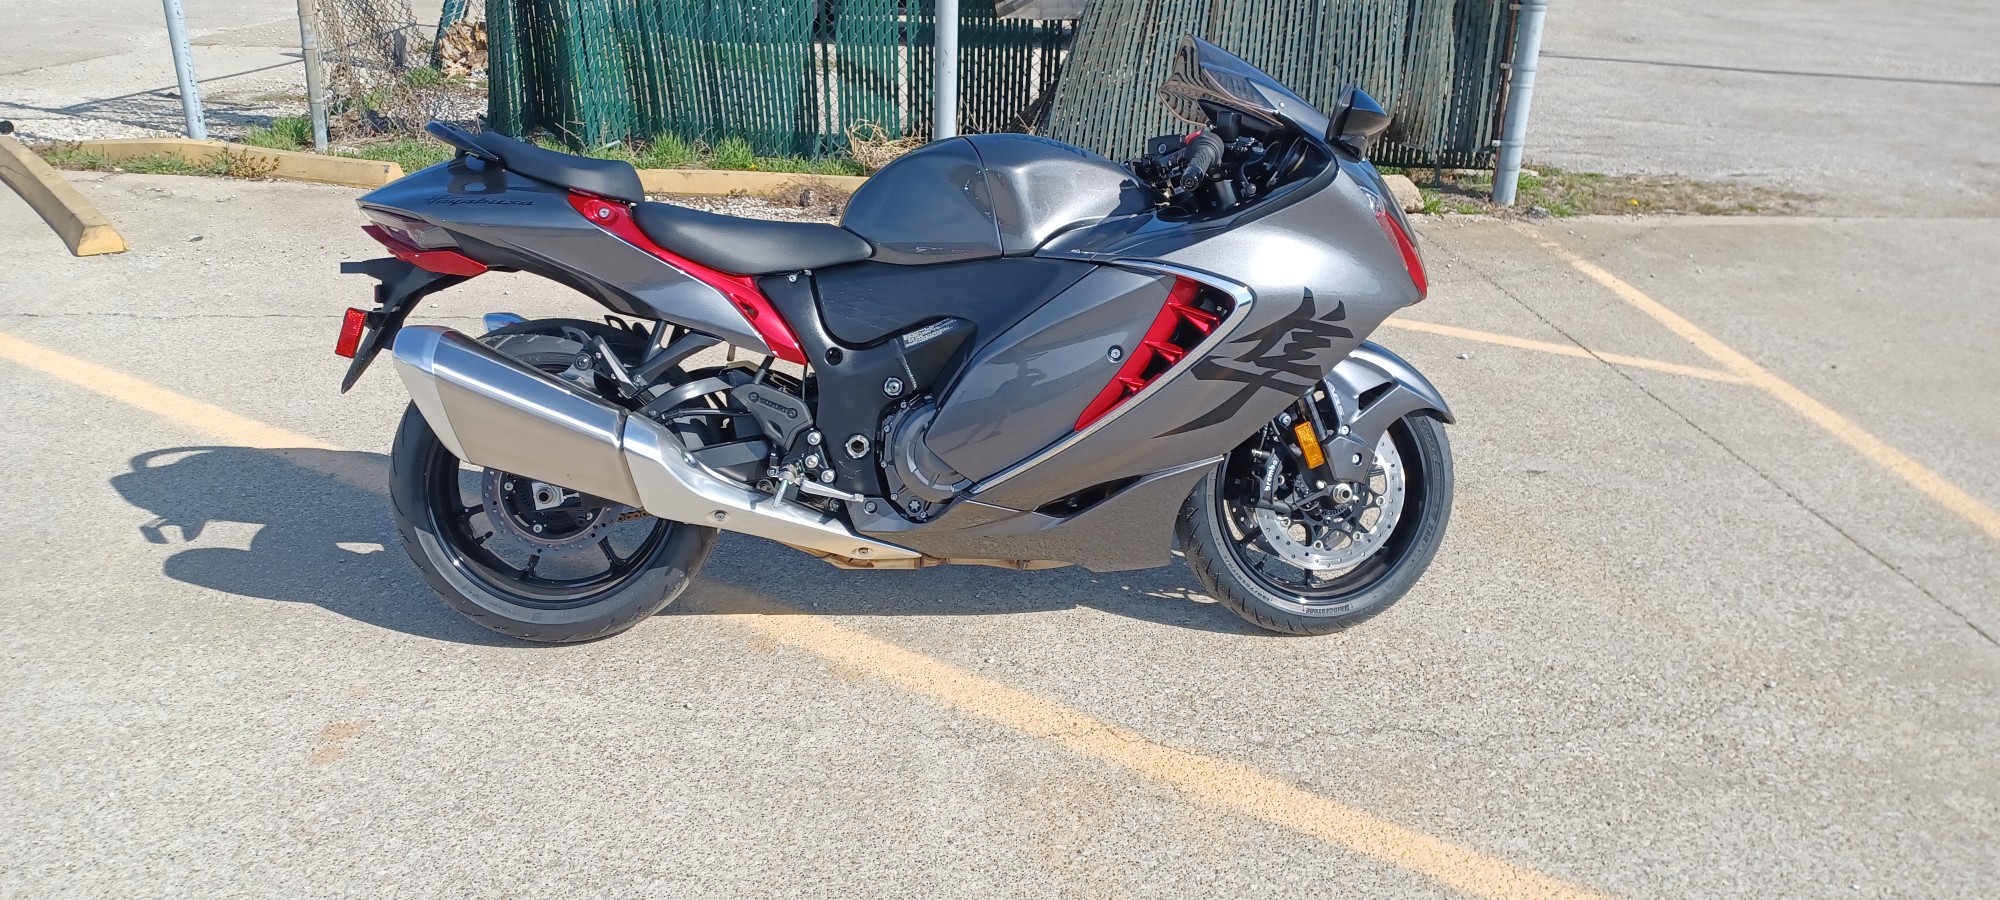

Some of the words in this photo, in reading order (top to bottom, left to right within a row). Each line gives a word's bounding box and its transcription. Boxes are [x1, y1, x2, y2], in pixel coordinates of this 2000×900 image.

[423, 194, 536, 206] Hayabusa
[1152, 286, 1354, 439] 隼
[759, 397, 789, 413] SUZUKI
[1264, 460, 1278, 492] brembo
[1305, 604, 1350, 616] BRIDGESTONE
